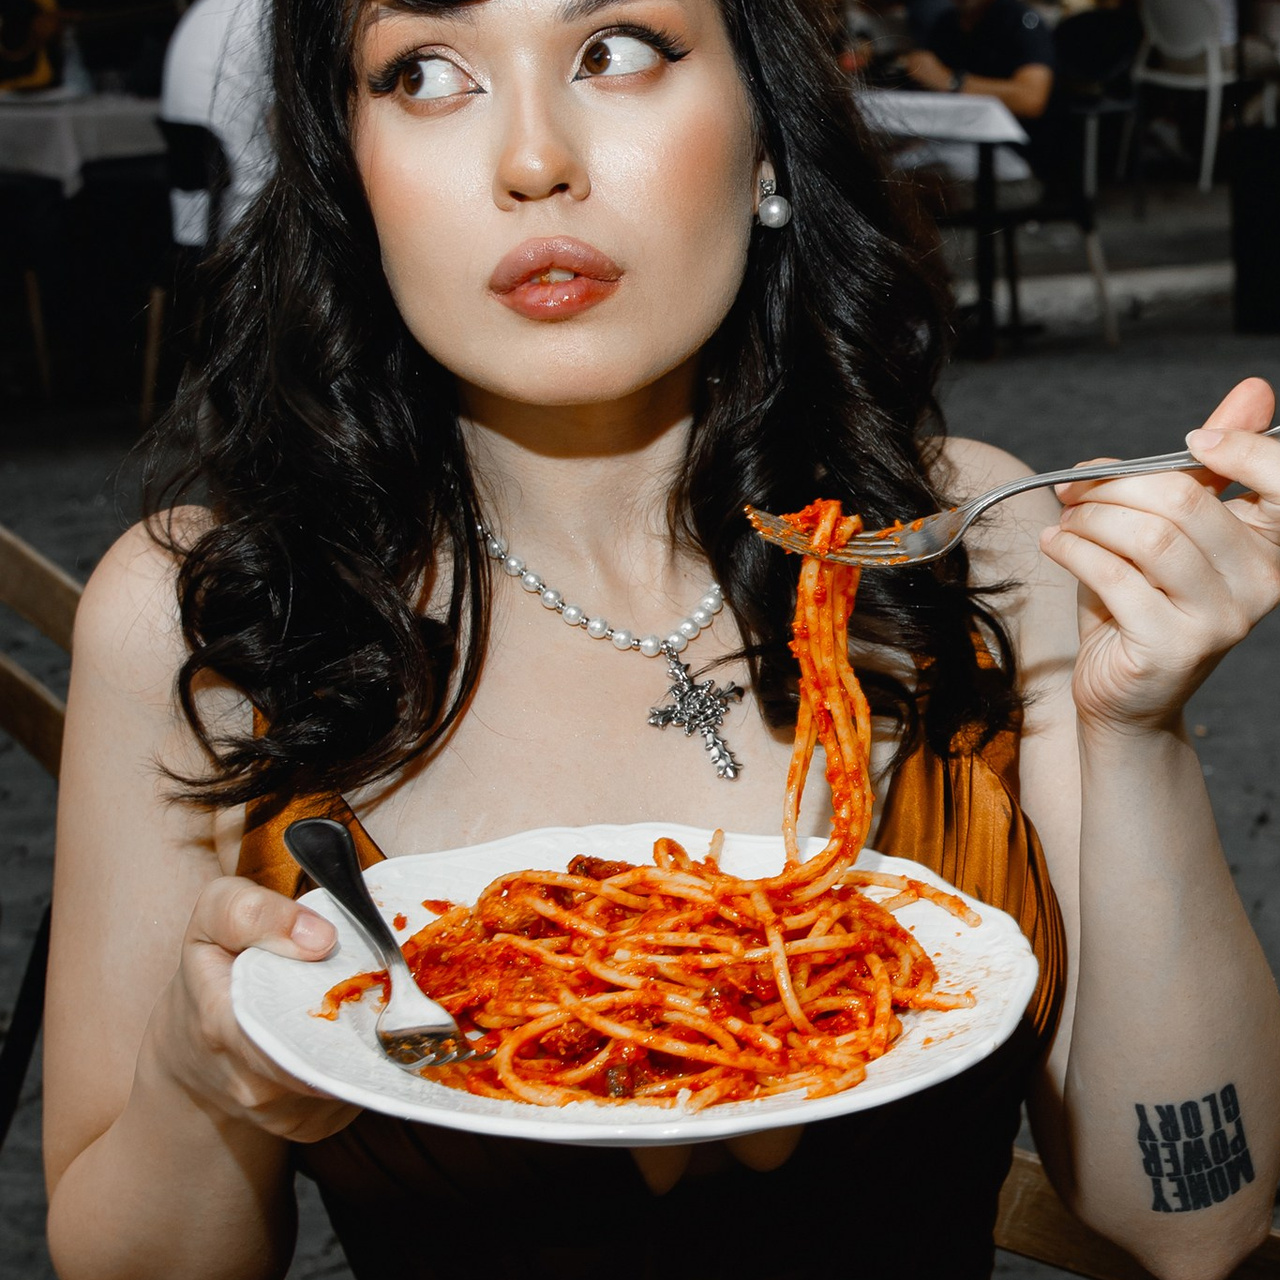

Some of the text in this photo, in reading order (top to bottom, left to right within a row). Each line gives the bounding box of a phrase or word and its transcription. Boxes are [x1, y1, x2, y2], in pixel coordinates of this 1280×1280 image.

[1134, 1083, 1240, 1142] GLORY
[1138, 1117, 1247, 1177] POWER
[1151, 1148, 1256, 1212] MONEY
